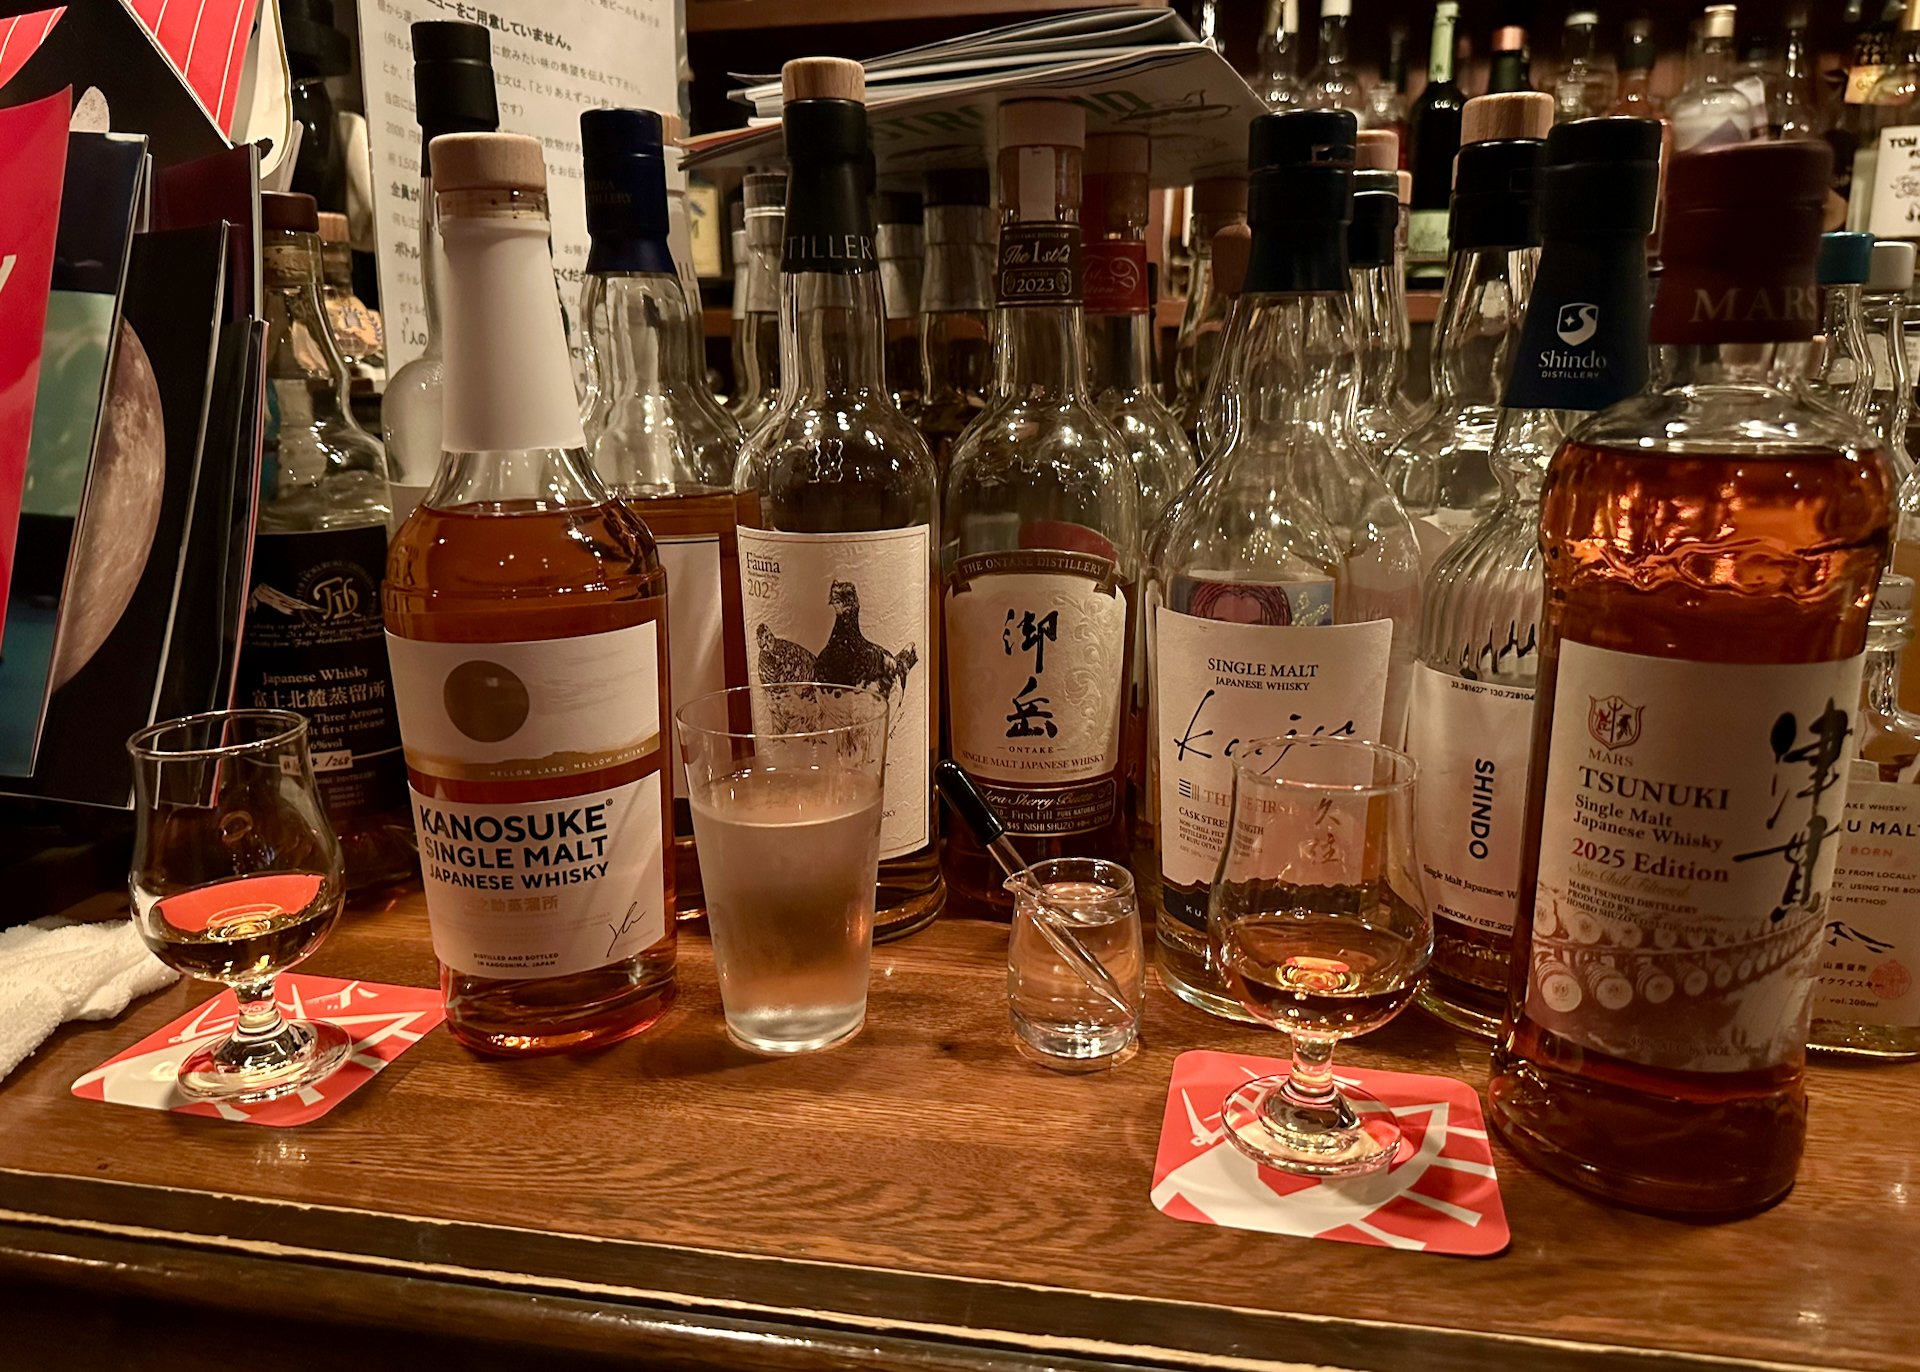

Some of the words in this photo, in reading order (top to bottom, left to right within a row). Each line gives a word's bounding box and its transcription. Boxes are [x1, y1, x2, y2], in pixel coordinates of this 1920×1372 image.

[1017, 278, 1055, 293] 2023
[1688, 285, 1818, 323] MARS
[1538, 350, 1608, 369] Shindo
[1541, 370, 1600, 379] DISTILLERY
[746, 552, 781, 574] Fauna
[962, 560, 983, 575] THE
[1036, 556, 1103, 576] DISTILLERY
[262, 672, 317, 687] Japanese
[319, 665, 369, 682] Whisky
[1207, 658, 1267, 677] SINGLE
[1269, 663, 1319, 678] MALT
[1215, 676, 1263, 690] JAPANESE
[1266, 681, 1311, 692] WHISKY
[314, 712, 346, 724] Three
[349, 707, 384, 720] Arrows
[321, 725, 345, 734] first
[347, 717, 385, 731] release
[574, 757, 612, 769] MELLOW
[616, 746, 646, 760] WHISKY
[1008, 746, 1055, 755] ONTAKE
[1588, 748, 1634, 767] MARS
[960, 750, 989, 766] SINGLE
[990, 757, 1019, 769] MALT
[1019, 760, 1071, 771] JAPANESE
[1071, 753, 1106, 768] WHISKY
[1578, 765, 1731, 811] TSUNUKI
[1008, 793, 1055, 811] Sherry
[1469, 758, 1495, 859] SHINDO
[1575, 794, 1625, 822] Single
[1629, 806, 1672, 828] Malt
[1869, 803, 1908, 812] WHISKY
[1011, 810, 1034, 820] First
[1036, 810, 1053, 820] Fill
[1179, 806, 1200, 822] CASK
[1024, 822, 1045, 832] NISHI
[1046, 821, 1074, 831] SHUZO
[1573, 811, 1646, 841] Japanese
[1651, 827, 1723, 854] Whisky
[425, 836, 515, 869] SINGLE
[524, 834, 609, 869] MALT
[1571, 838, 1625, 868] 2025
[1632, 851, 1730, 883] Edition
[1850, 846, 1894, 858] BORN
[429, 858, 515, 891] JAPANESE
[521, 861, 609, 889] WHISKY
[1424, 863, 1443, 881] Single
[1444, 870, 1462, 887] Malt
[1463, 879, 1505, 899] Japanese
[1848, 869, 1875, 878] FROM
[1877, 871, 1918, 881] LOCALLY
[1567, 888, 1615, 909] PRODUCED
[1569, 879, 1591, 892] MARS
[1594, 886, 1635, 905] TSUNUKI
[1637, 898, 1698, 914] DISTILLERY
[1850, 884, 1877, 893] USING
[1879, 886, 1900, 894] THE
[1846, 897, 1888, 906] METHOD
[1437, 904, 1473, 922] FUKUOKA
[508, 953, 524, 961] AND
[525, 952, 559, 961] BOTTLED
[532, 960, 556, 968] JAPAN
